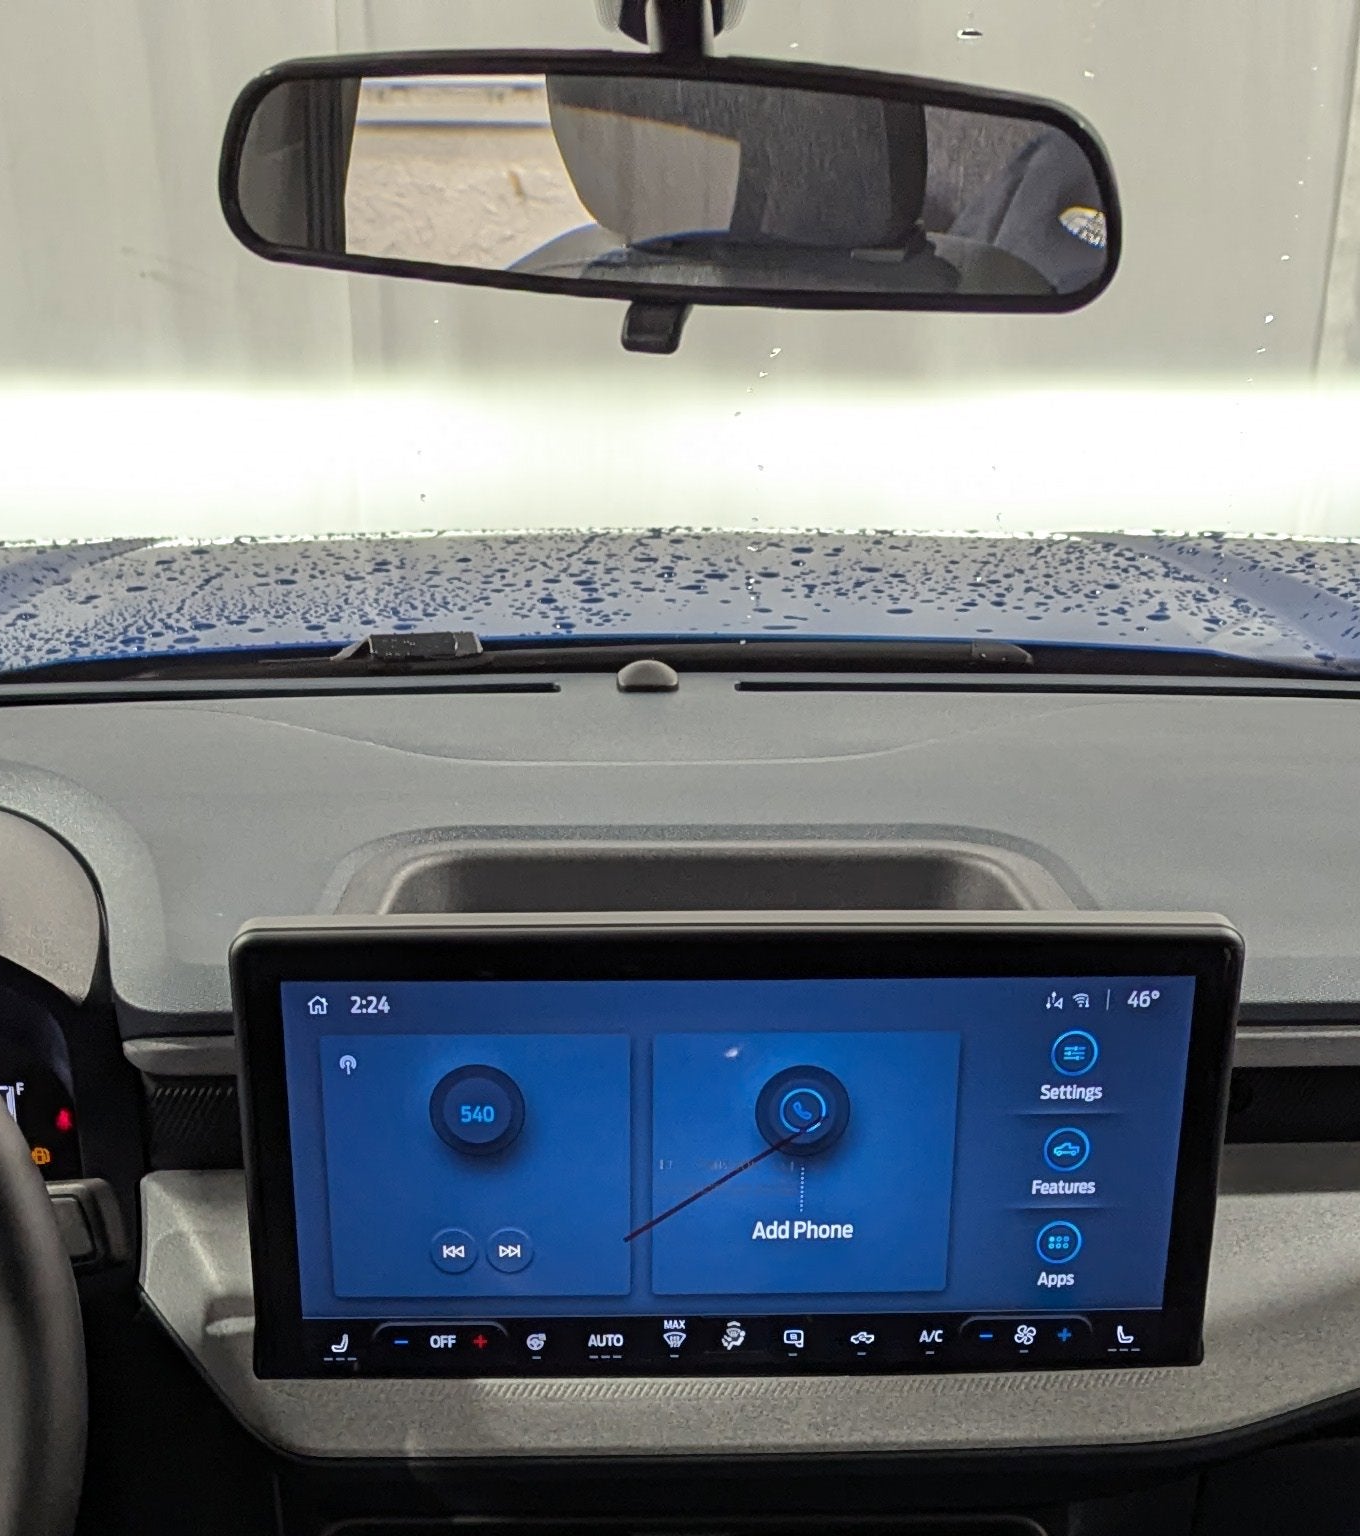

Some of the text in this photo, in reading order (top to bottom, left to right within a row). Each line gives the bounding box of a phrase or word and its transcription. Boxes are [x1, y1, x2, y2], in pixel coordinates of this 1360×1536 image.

[350, 996, 390, 1014] 2:24
[16, 1082, 25, 1096] F
[1040, 1084, 1103, 1102] Settings
[460, 1105, 495, 1123] 540
[1031, 1179, 1096, 1196] Features
[751, 1219, 854, 1240] Add Phone
[1036, 1271, 1076, 1289] Apps
[663, 1319, 686, 1330] MAX
[430, 1334, 456, 1349] OFF
[587, 1333, 625, 1349] AUTO
[919, 1329, 944, 1344] A/C
